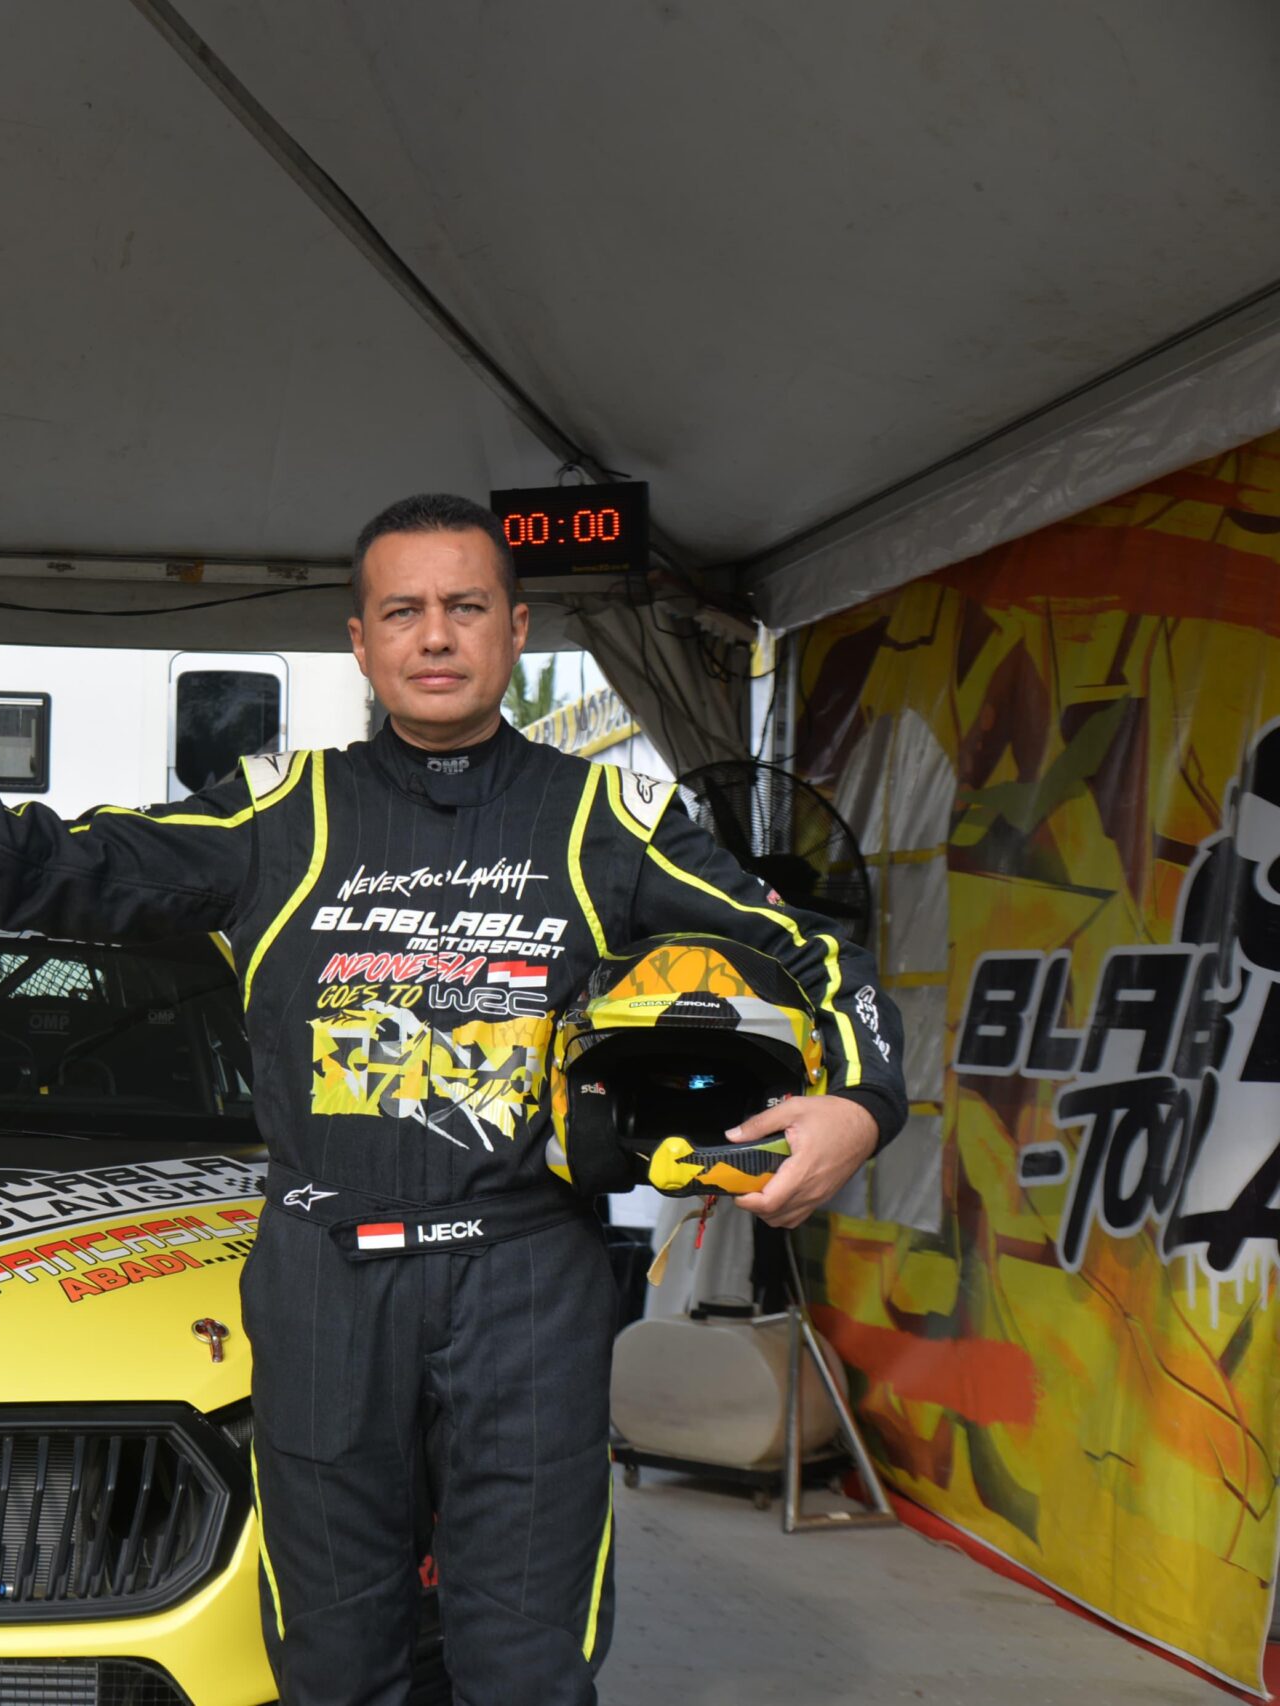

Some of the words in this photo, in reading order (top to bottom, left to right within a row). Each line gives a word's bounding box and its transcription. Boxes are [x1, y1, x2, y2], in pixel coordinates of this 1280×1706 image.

[505, 508, 620, 546] 00:00
[310, 905, 568, 943] BLABLABLA
[405, 936, 566, 960] MOTORSPORT
[317, 951, 488, 987] INDONESIA
[315, 983, 382, 1010] GOES
[389, 983, 424, 1009] TO
[29, 1013, 70, 1032] OMP
[417, 1219, 484, 1243] IJECK
